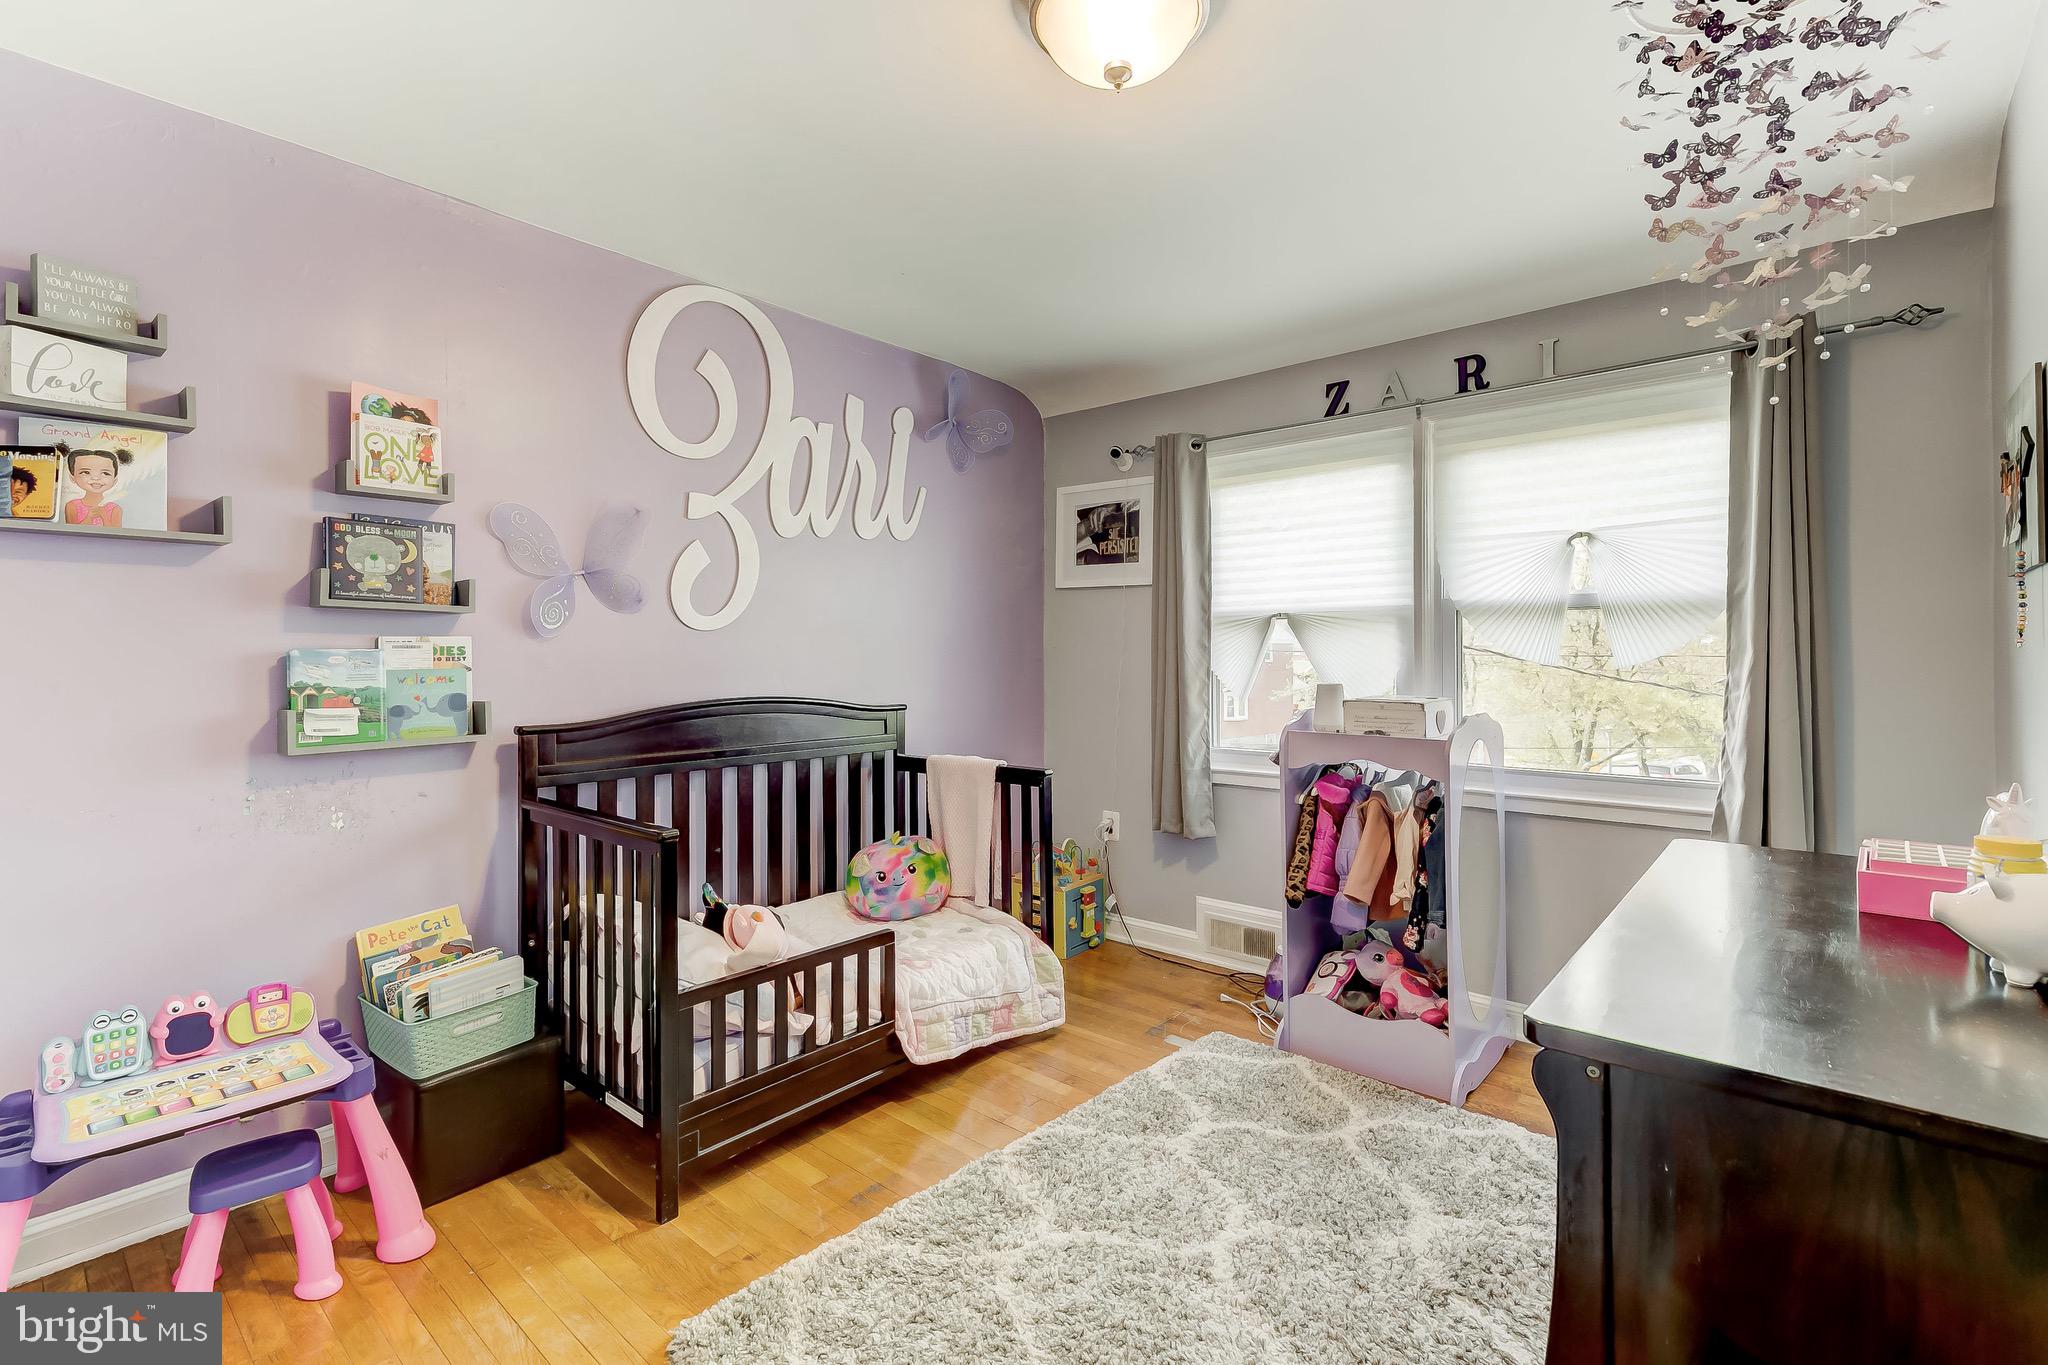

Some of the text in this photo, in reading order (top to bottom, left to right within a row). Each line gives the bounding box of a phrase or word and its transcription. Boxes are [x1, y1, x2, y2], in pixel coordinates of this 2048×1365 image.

[70, 270, 115, 289] ALWAYS
[45, 276, 131, 306] YOUR LITTLE GIRL
[44, 288, 131, 318] YOU'LL ALWAYS
[68, 308, 89, 320] MY
[97, 314, 131, 330] HERO
[41, 424, 143, 447] Grand Angel
[8, 451, 55, 463] Morning
[626, 284, 927, 632] Zari
[334, 523, 352, 532] GOD
[355, 525, 381, 535] BLESS
[393, 529, 417, 540] MOON
[397, 672, 455, 686] welcome
[367, 914, 451, 949] Pete the Cat
